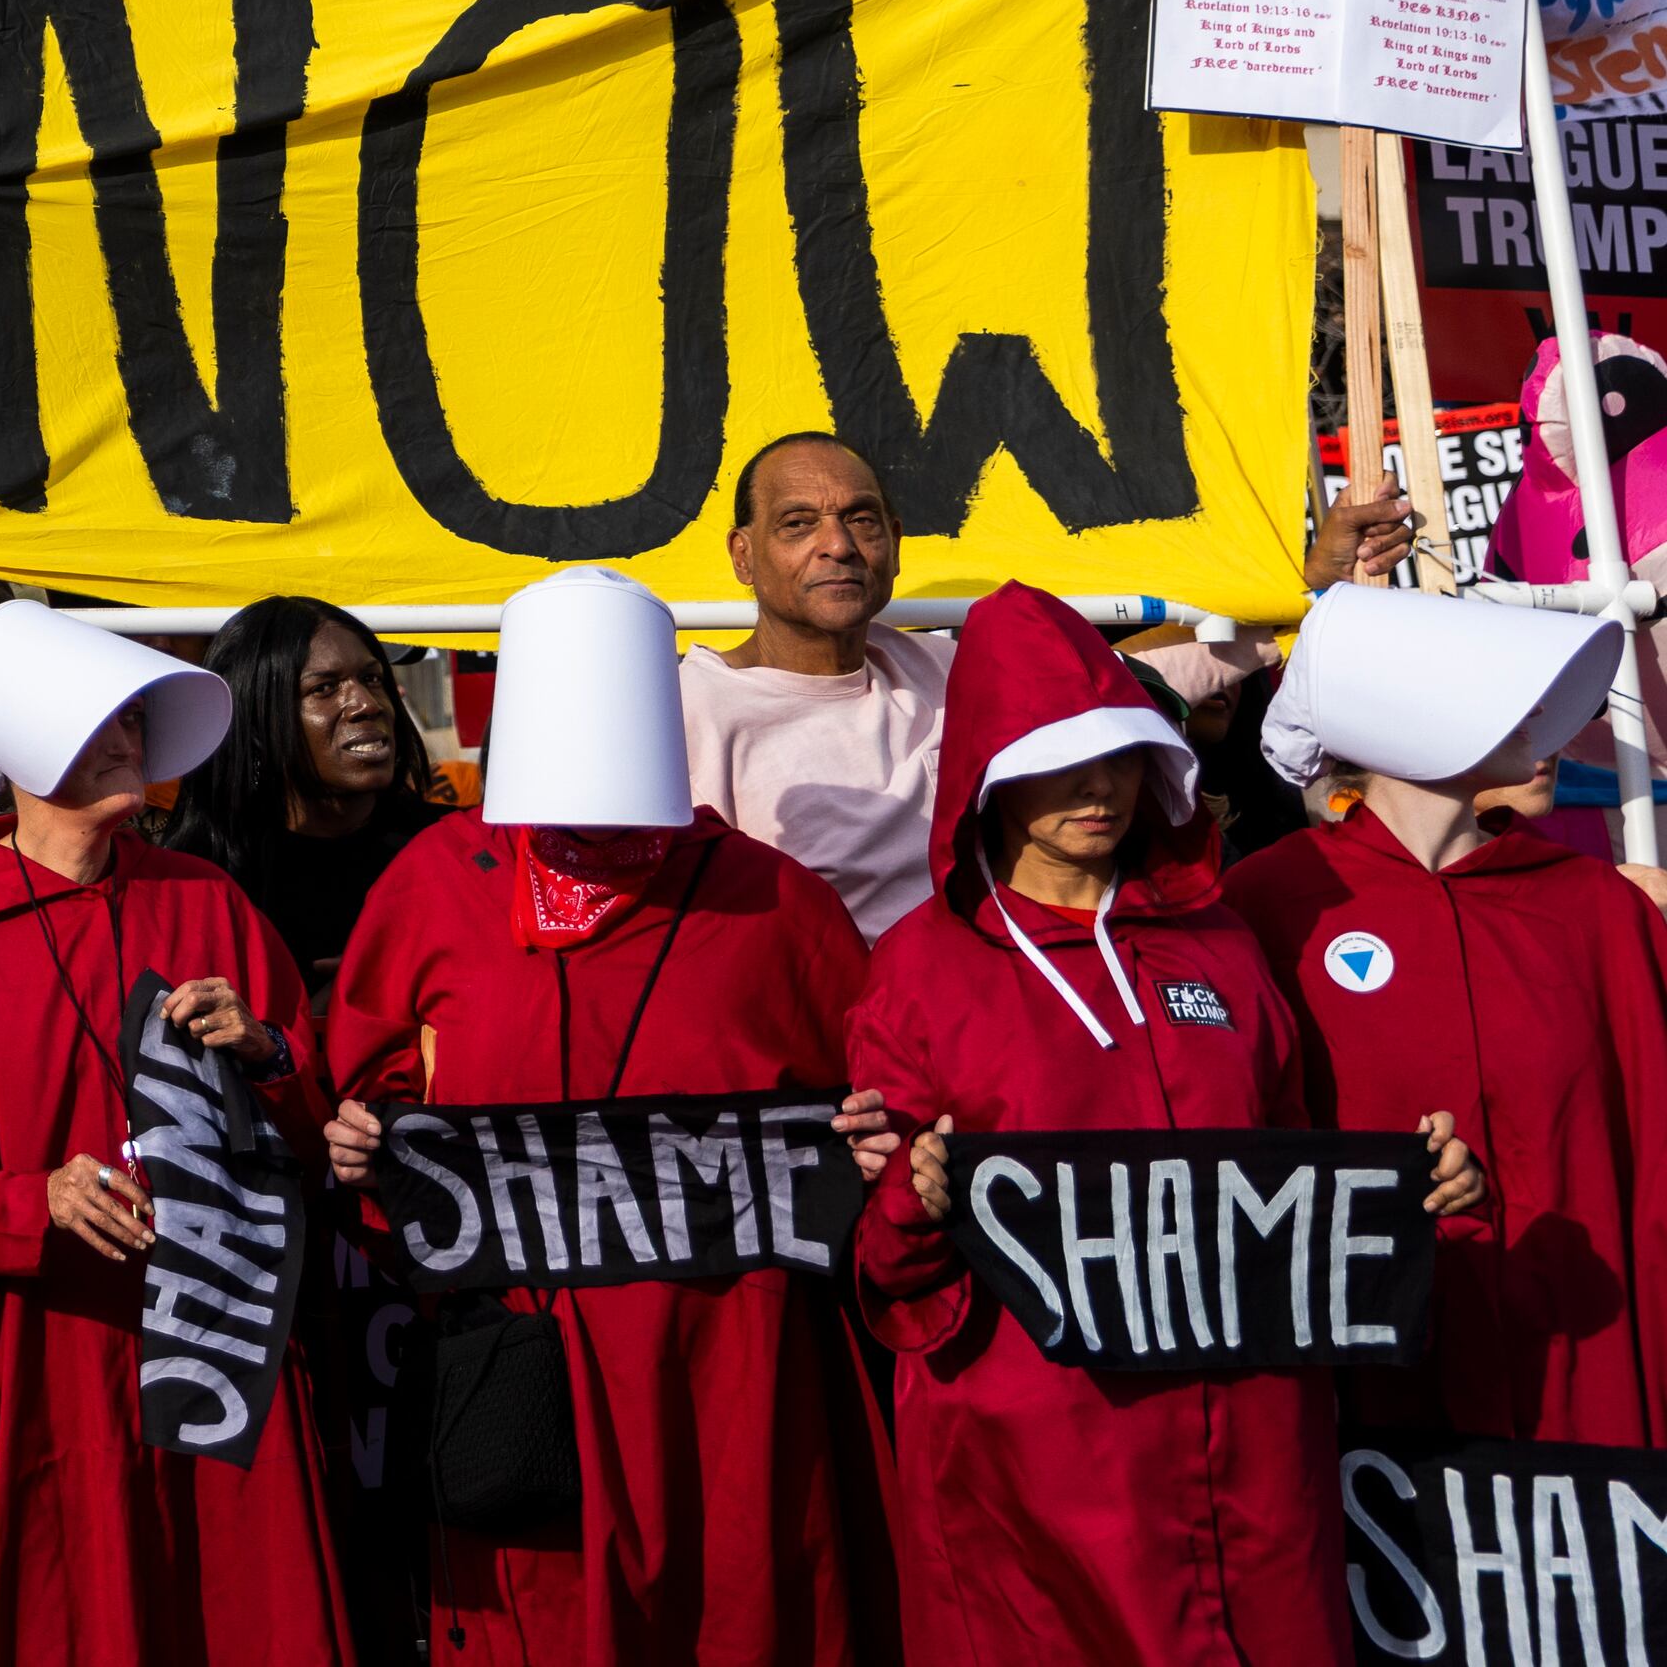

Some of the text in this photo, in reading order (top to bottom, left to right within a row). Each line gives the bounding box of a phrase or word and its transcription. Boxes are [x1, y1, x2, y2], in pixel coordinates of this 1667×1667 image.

[1185, 0, 1250, 13] Revelation
[1398, 1, 1481, 22] YES KING
[1200, 20, 1315, 38] King of Kings and
[1370, 16, 1431, 34] Revelation
[1214, 38, 1301, 54] Lord of Lords
[1383, 38, 1491, 64] King of Kings and
[1190, 57, 1239, 70] FREE
[1396, 58, 1478, 80] Lord of Lords
[1374, 76, 1419, 91] FREE
[1168, 1003, 1227, 1021] TRUMP
[387, 1103, 838, 1272] SHAME
[970, 1154, 1399, 1354] SHAME
